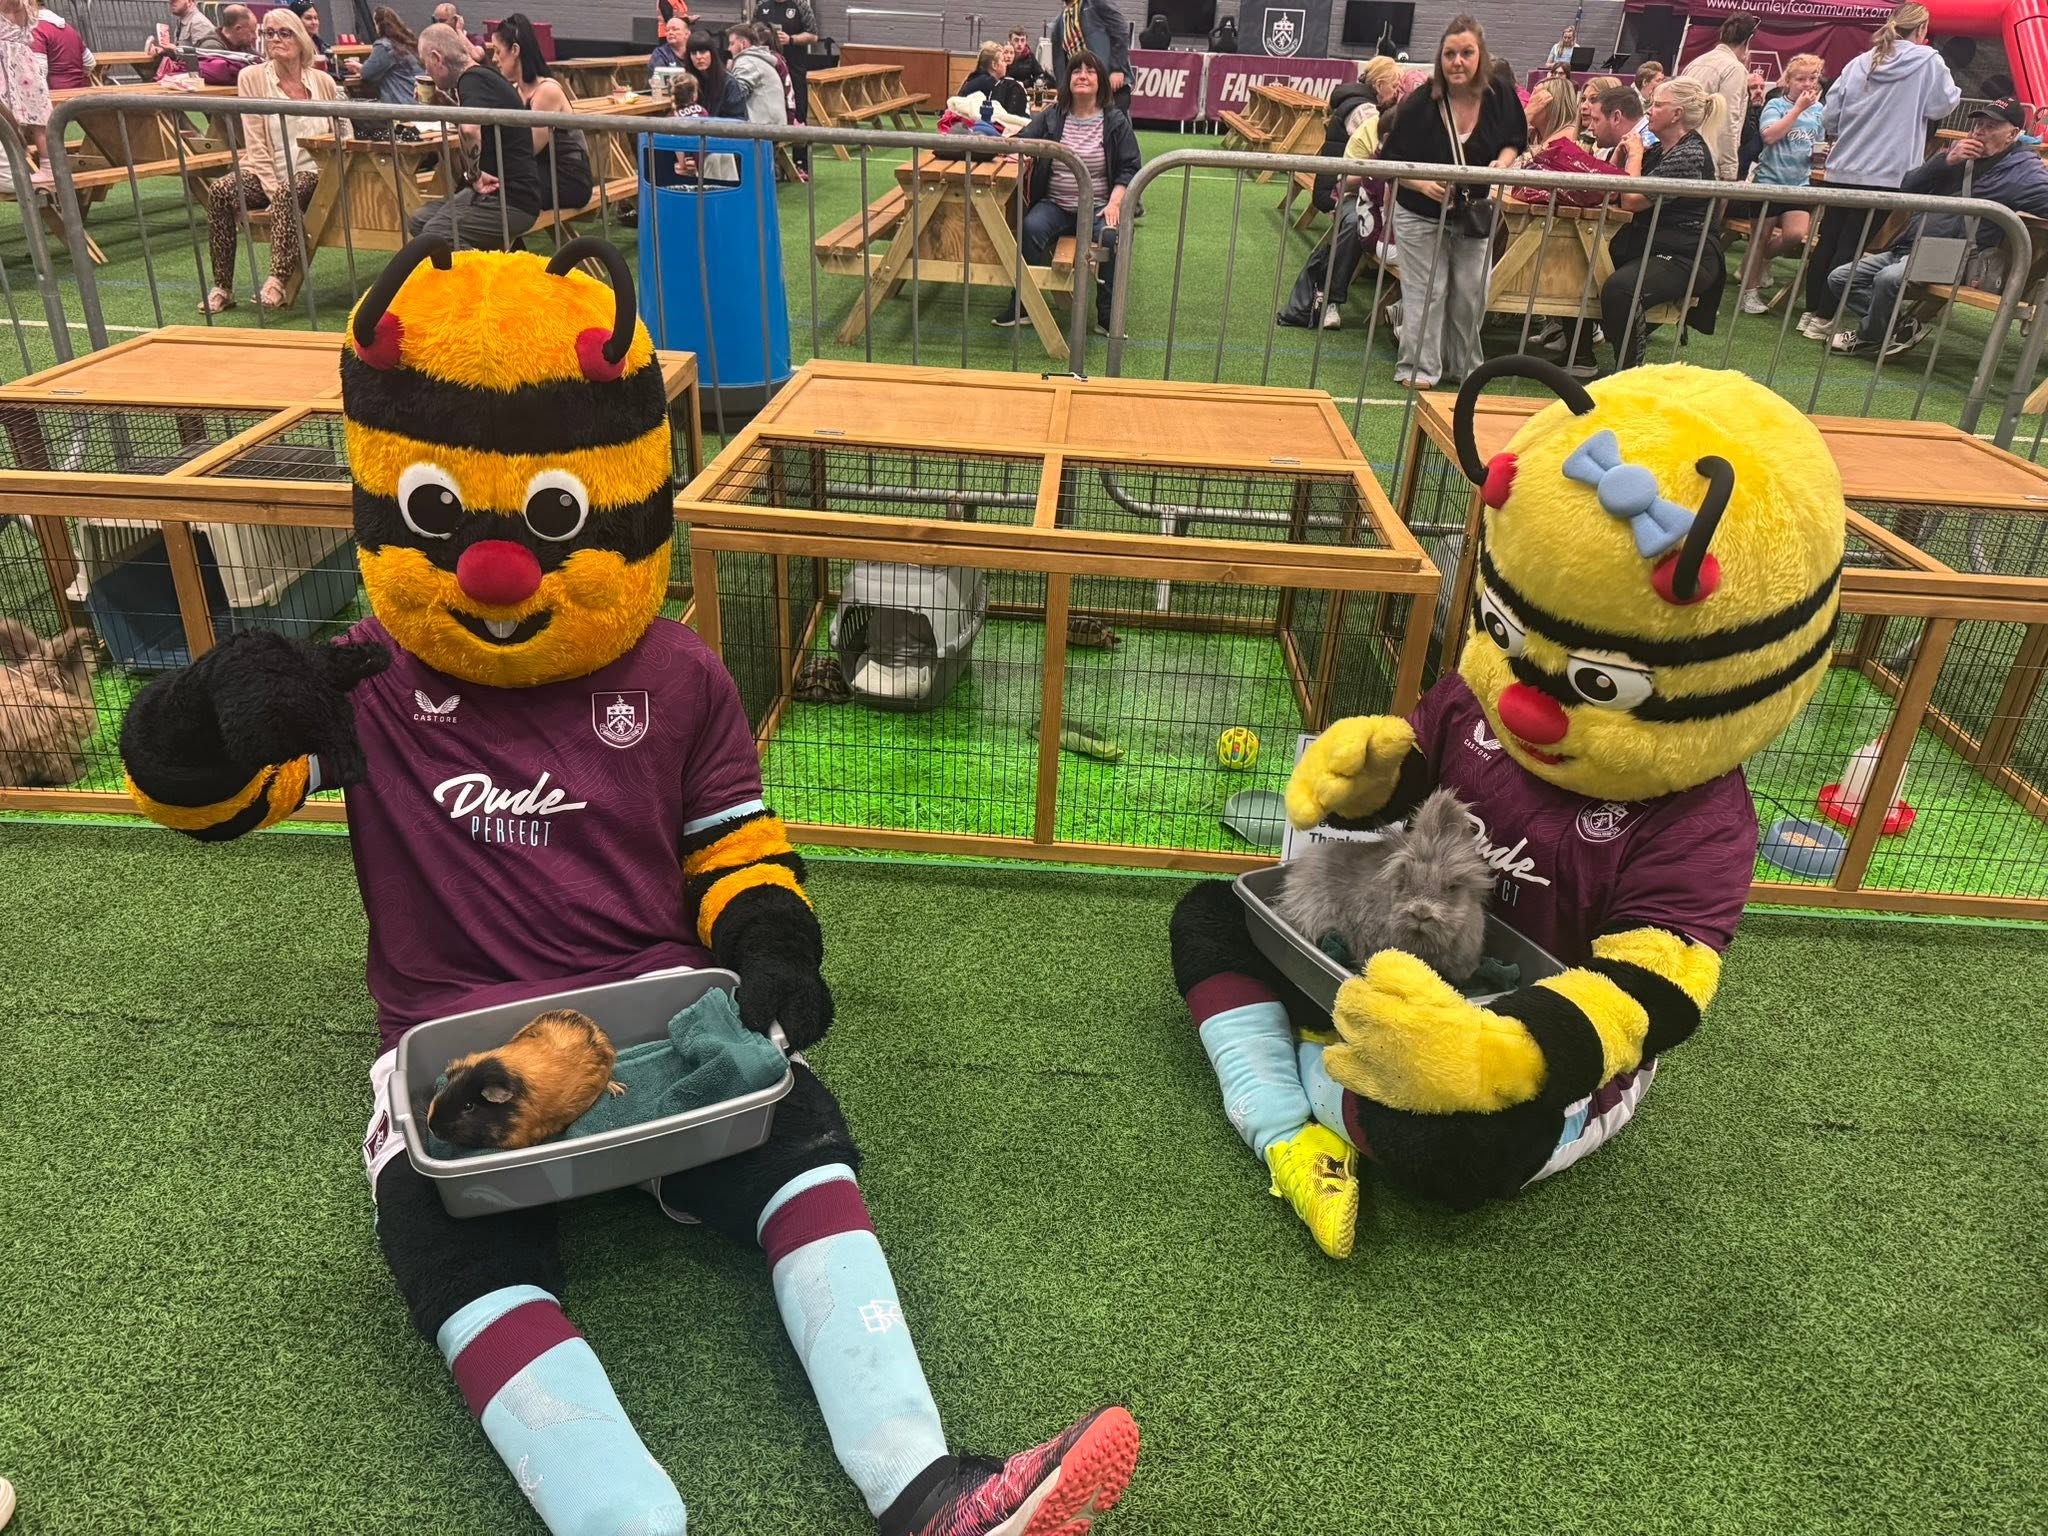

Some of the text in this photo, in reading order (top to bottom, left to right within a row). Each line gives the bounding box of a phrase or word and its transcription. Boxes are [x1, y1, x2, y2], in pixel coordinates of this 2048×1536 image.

[1131, 67, 1190, 98] ZONE
[1219, 72, 1264, 103] FAN
[413, 713, 457, 724] CASTORE
[1463, 738, 1492, 761] CASTORE
[432, 771, 588, 819] Dude
[471, 816, 551, 847] PERFECT
